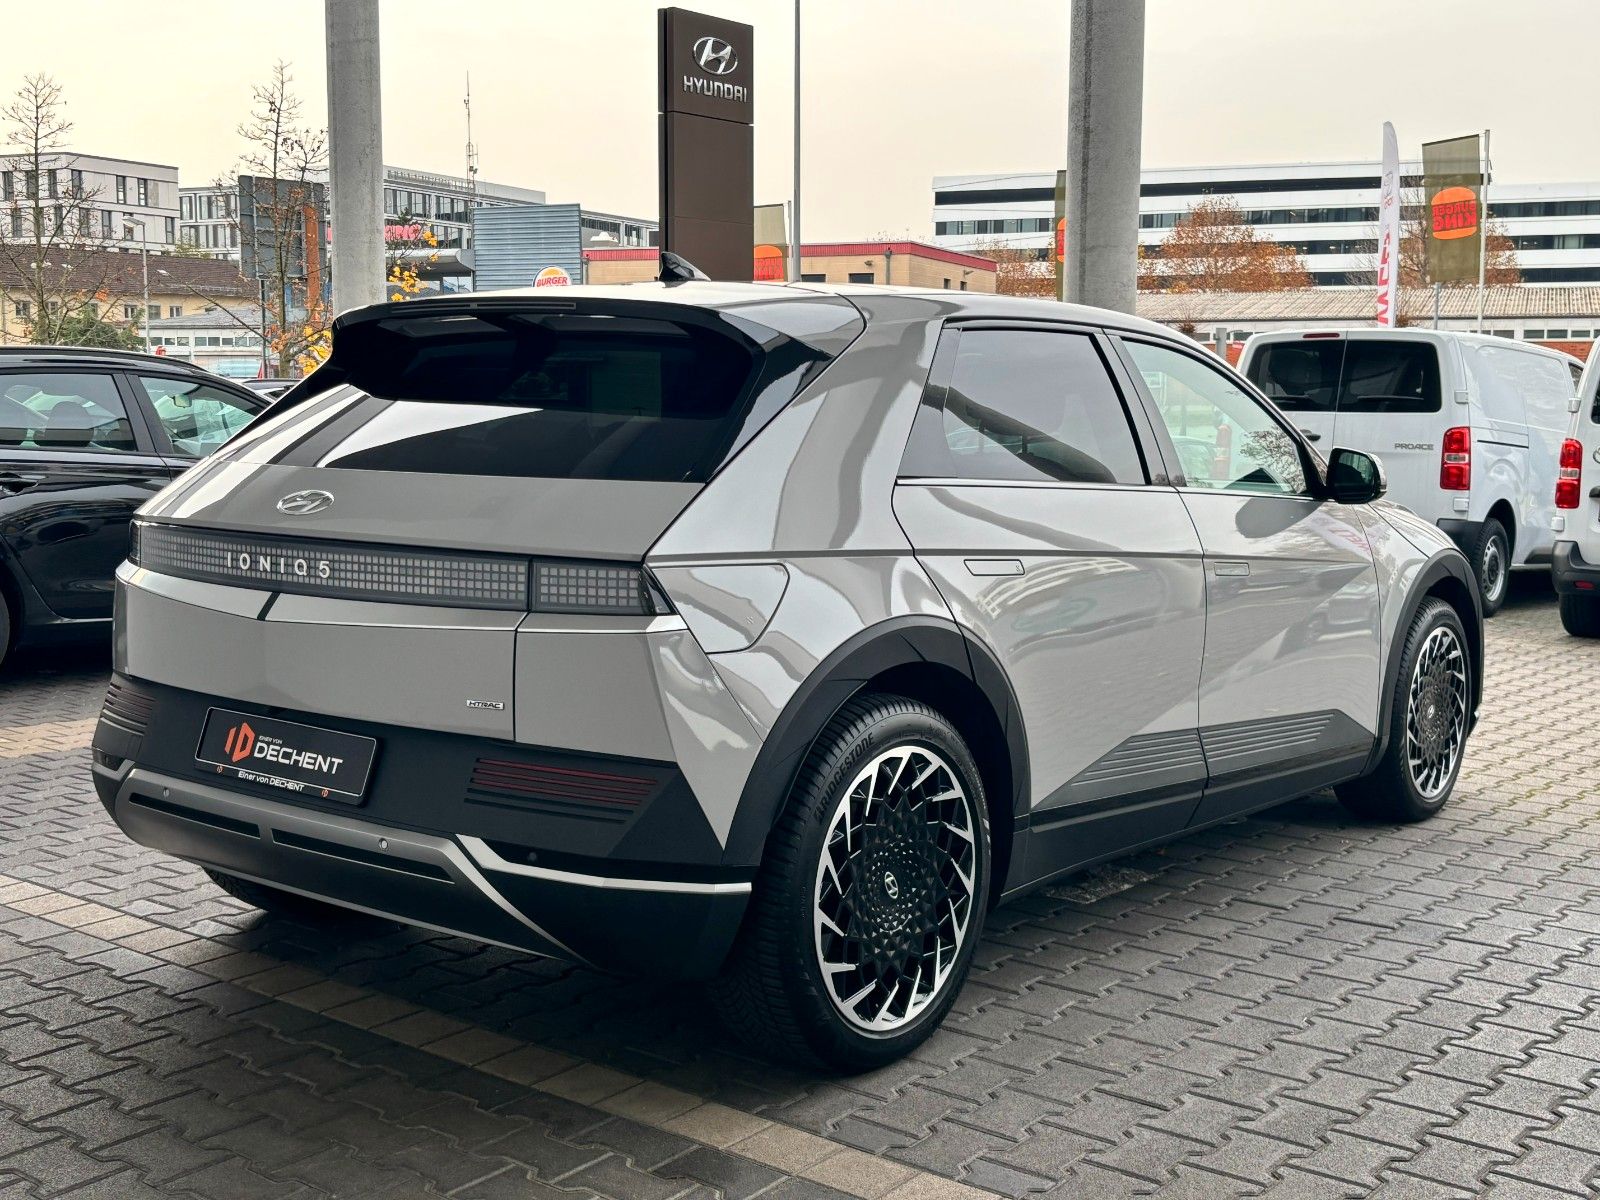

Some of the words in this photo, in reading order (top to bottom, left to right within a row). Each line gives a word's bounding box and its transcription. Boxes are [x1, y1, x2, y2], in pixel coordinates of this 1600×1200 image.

[683, 75, 747, 102] HYUNDAI
[536, 276, 568, 287] BURGER
[1394, 443, 1434, 451] PROACE
[227, 552, 308, 576] IONIQ
[319, 560, 331, 579] 5
[468, 700, 502, 709] HTRAC
[253, 741, 344, 775] DECHENT
[238, 770, 257, 781] Einer
[256, 774, 270, 784] von
[269, 777, 305, 793] DECHENT
